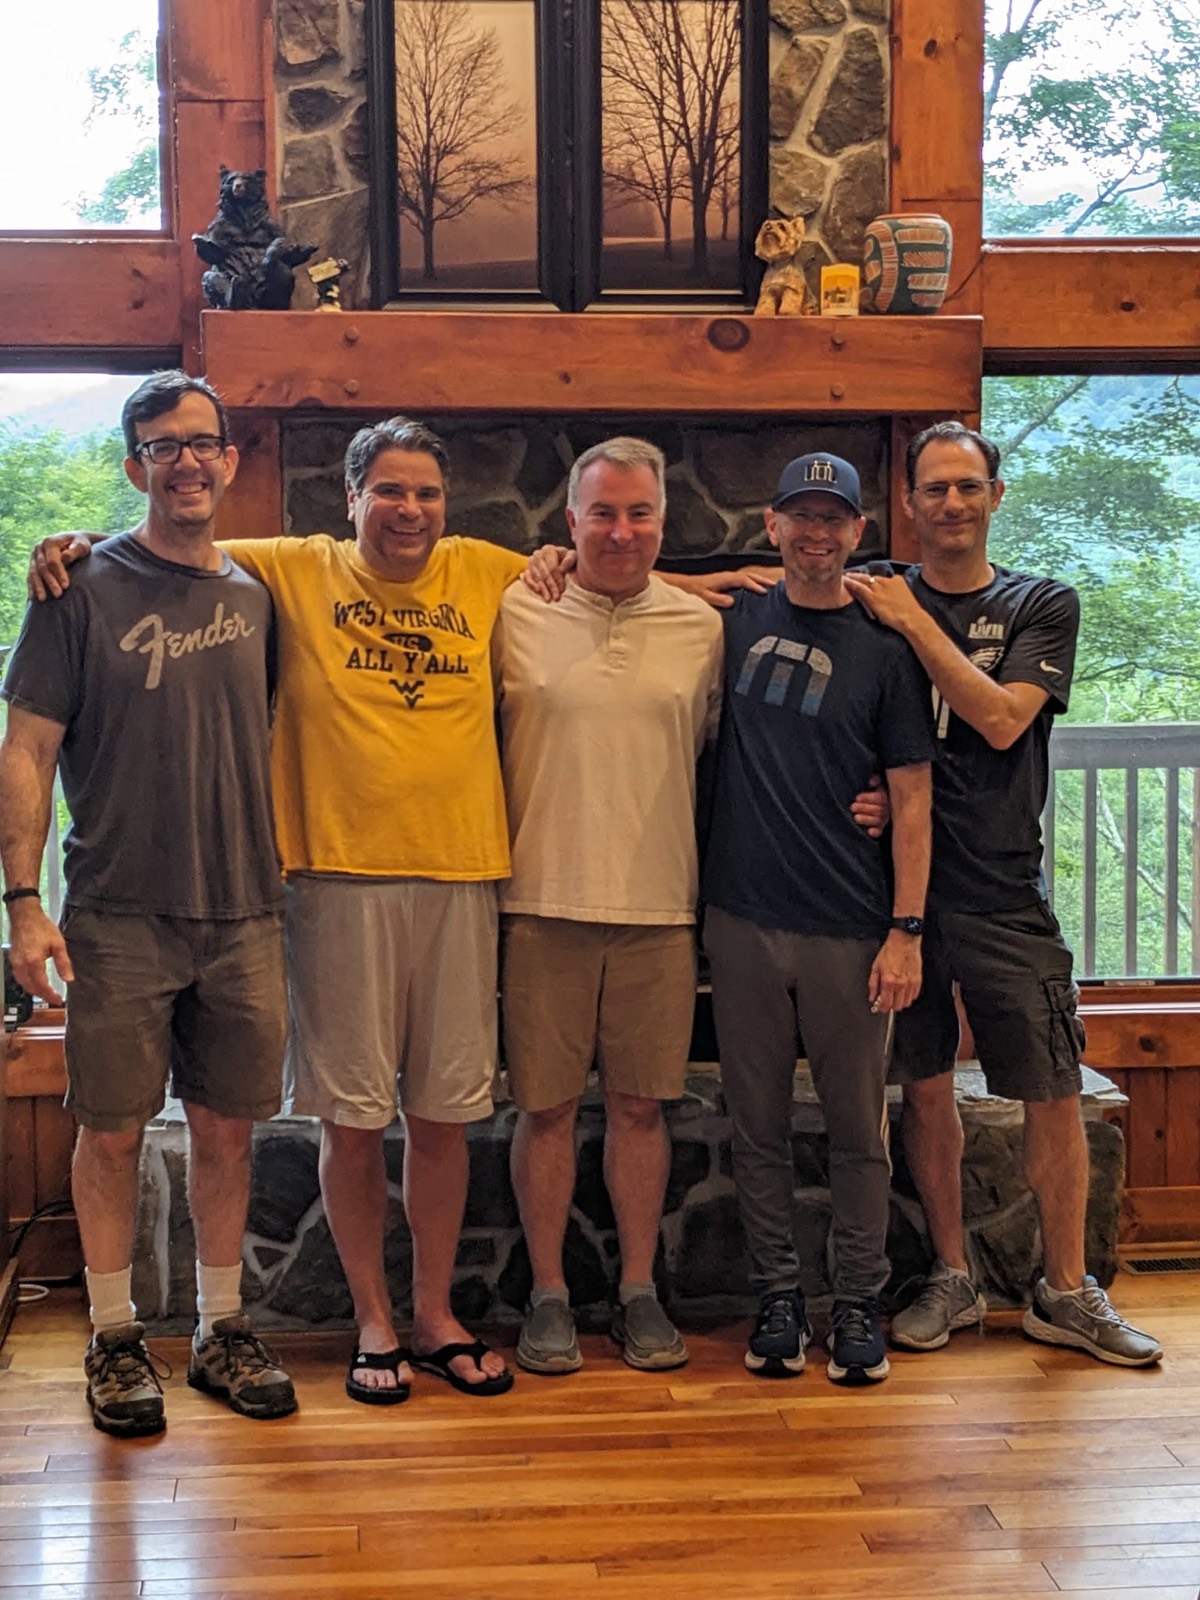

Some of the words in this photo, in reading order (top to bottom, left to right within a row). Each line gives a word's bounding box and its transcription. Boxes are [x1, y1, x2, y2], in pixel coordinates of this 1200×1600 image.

[392, 603, 476, 640] VIRGINIA
[119, 602, 255, 690] Fender
[345, 647, 393, 672] ALL
[402, 651, 469, 674] Y'ALL
